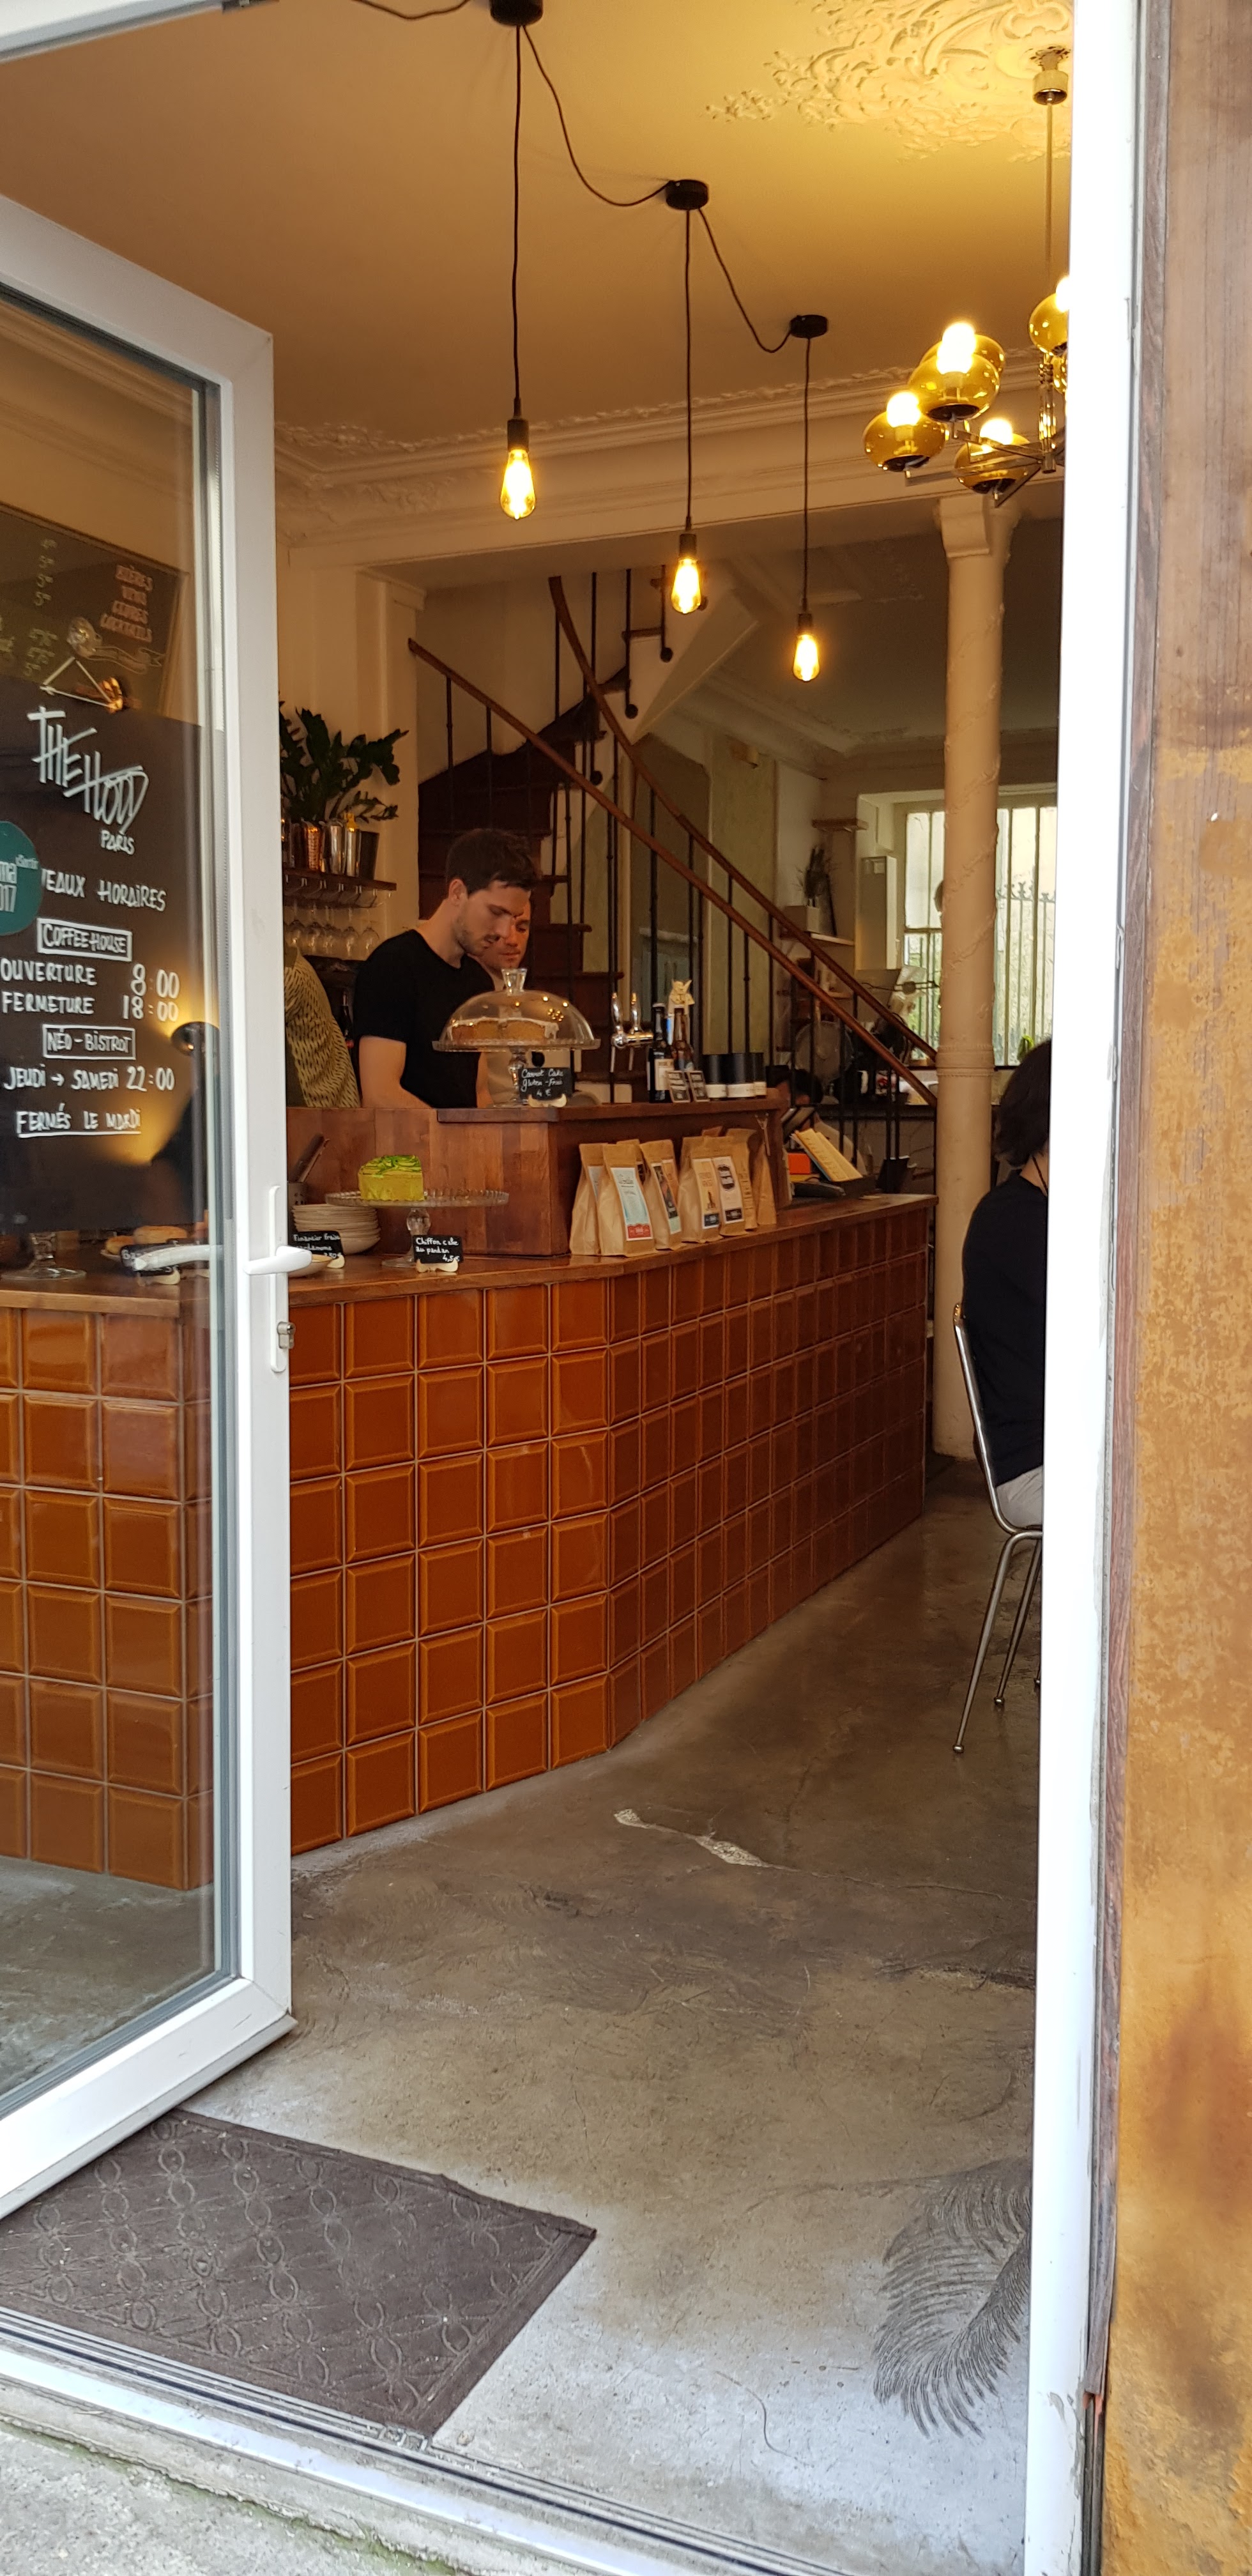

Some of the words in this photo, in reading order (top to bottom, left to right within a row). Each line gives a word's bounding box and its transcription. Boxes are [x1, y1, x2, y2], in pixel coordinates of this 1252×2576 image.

[27, 706, 97, 787] THE
[63, 751, 149, 834] HOOD
[1, 958, 97, 986] OUVERTURE
[2, 992, 95, 1015] FERMETURE
[126, 1066, 175, 1091] 22:00
[521, 1068, 544, 1078] Carrot
[548, 1068, 564, 1077] Cake
[83, 1110, 98, 1130] LE
[416, 1237, 441, 1245] Chiffon
